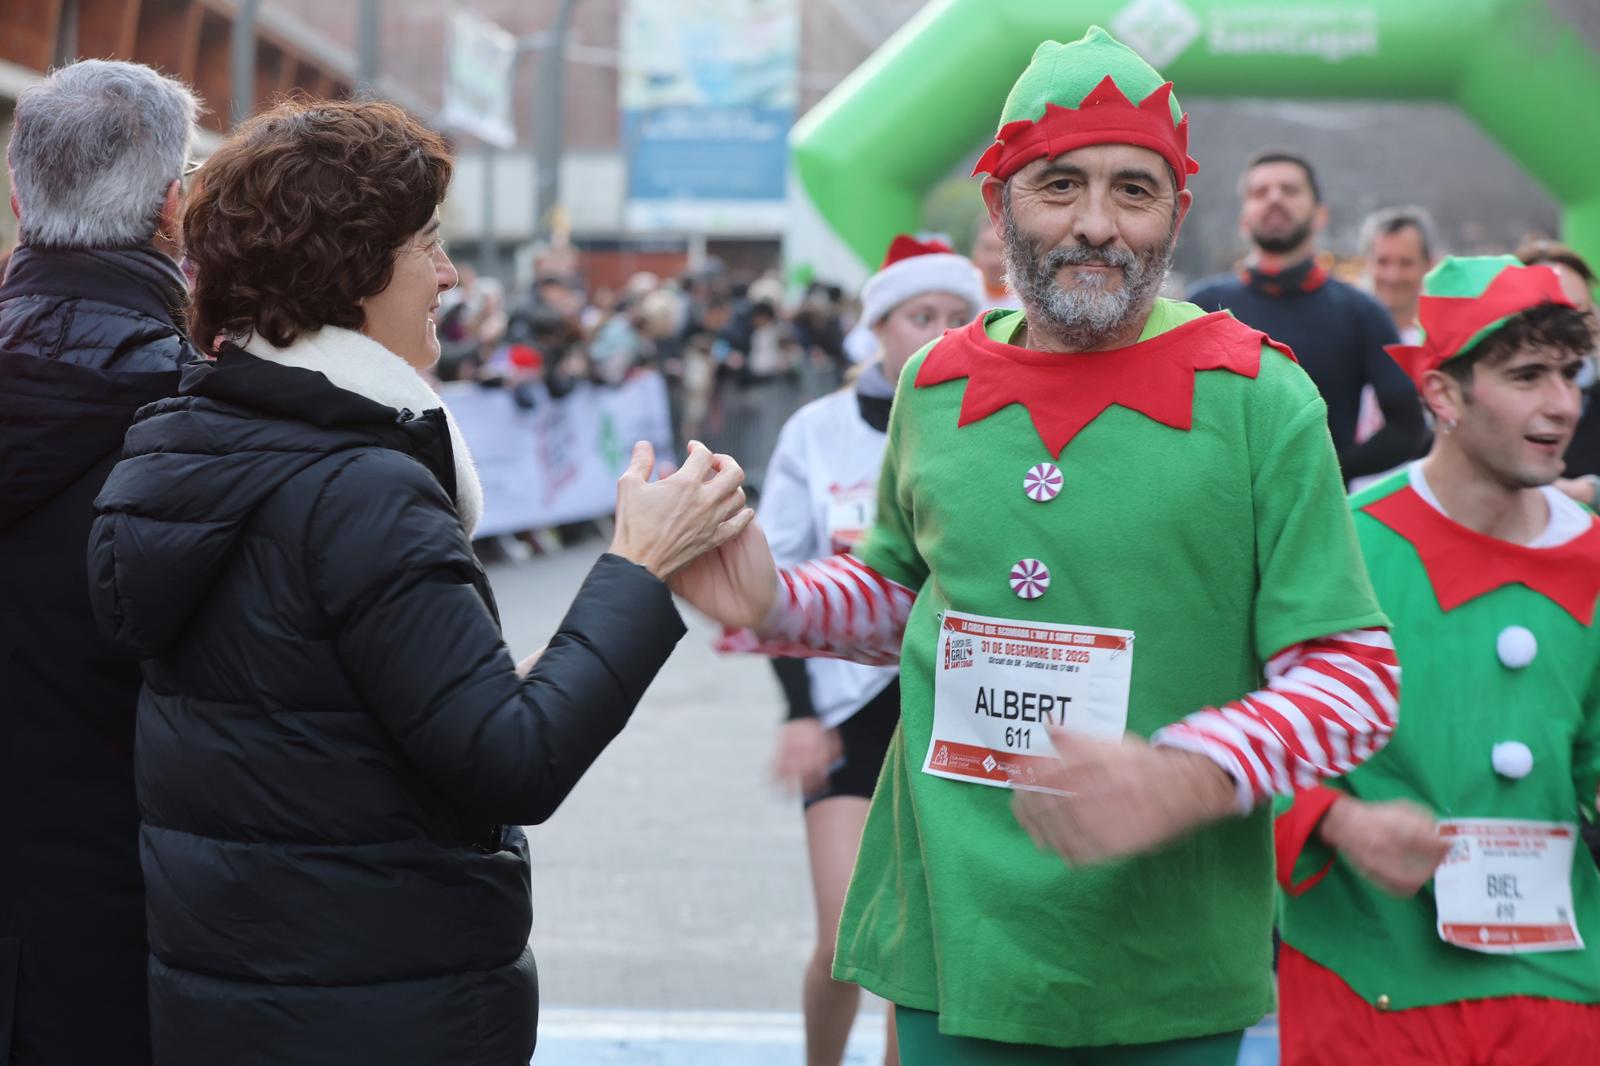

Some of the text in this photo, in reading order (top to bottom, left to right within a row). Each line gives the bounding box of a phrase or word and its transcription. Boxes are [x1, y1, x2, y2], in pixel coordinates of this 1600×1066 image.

[951, 648, 967, 660] GALL
[981, 640, 1090, 663] 31 DE DESEMBRE DE 2025
[951, 660, 973, 669] SANT CUGAT
[975, 686, 1072, 726] ALBERT
[1005, 726, 1031, 749] 611
[1486, 874, 1523, 899] BIEL
